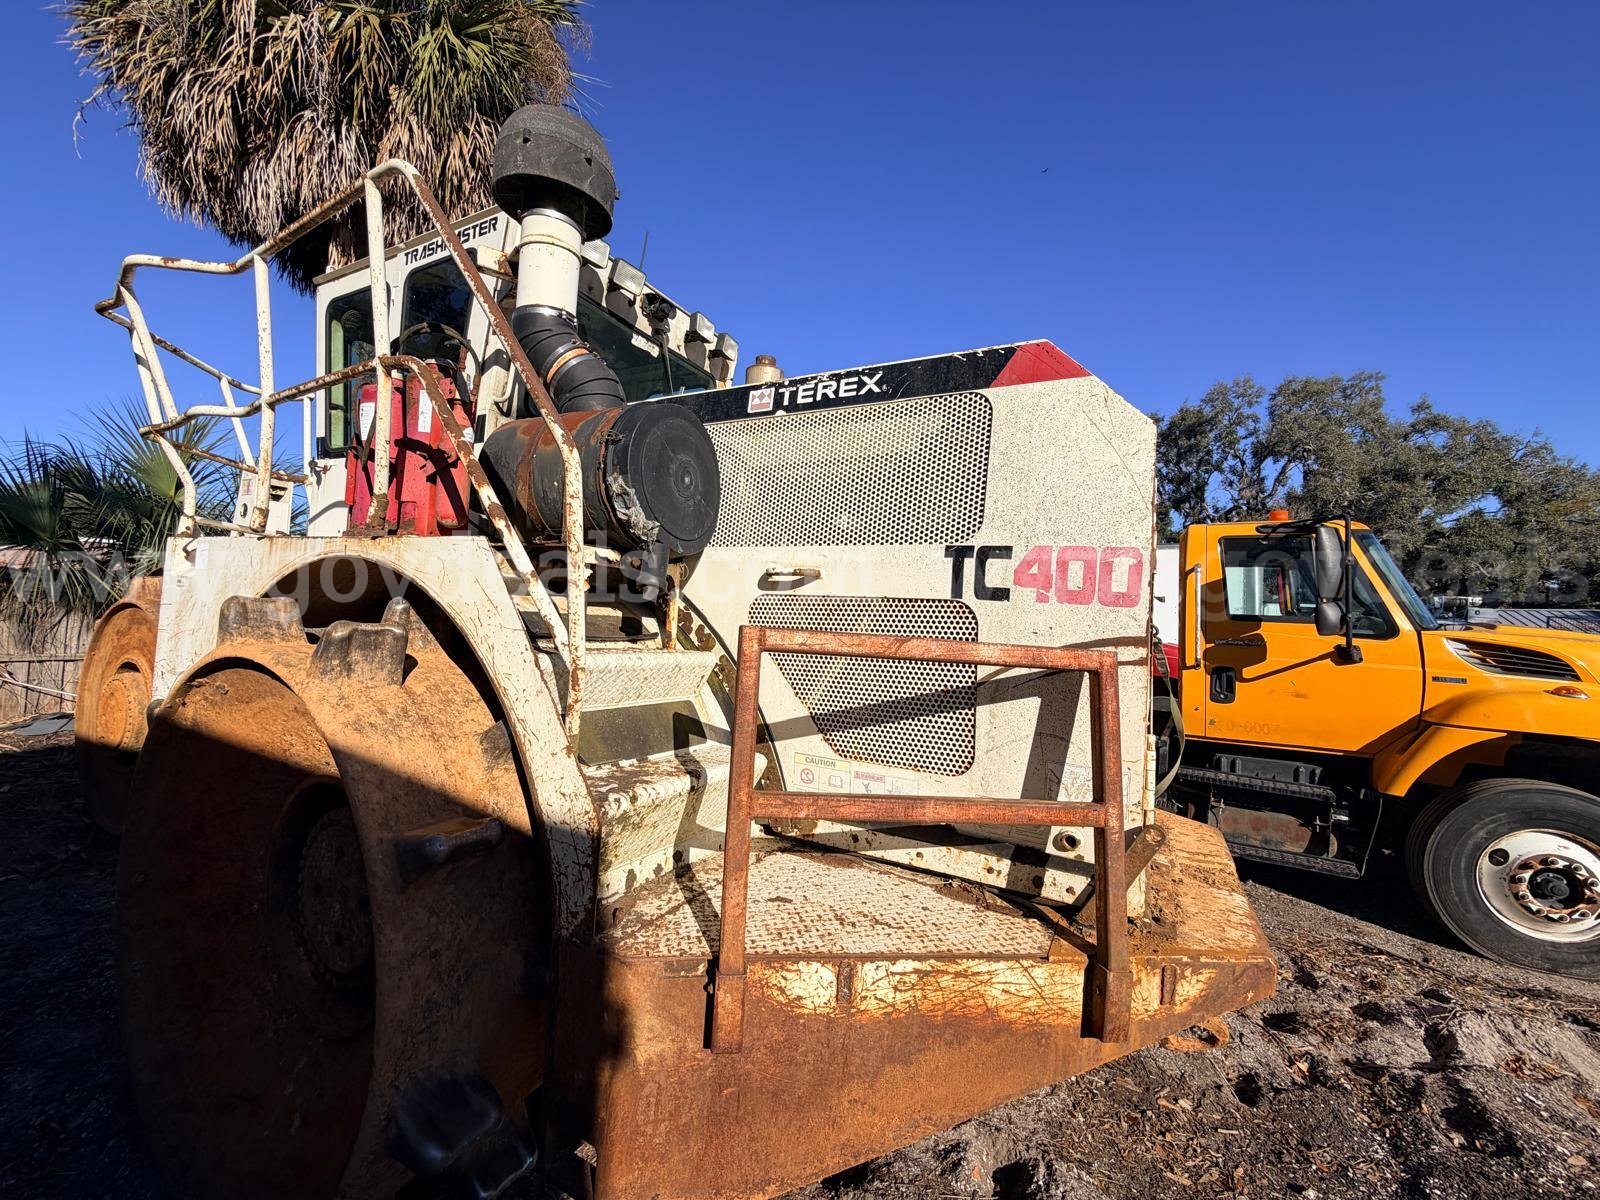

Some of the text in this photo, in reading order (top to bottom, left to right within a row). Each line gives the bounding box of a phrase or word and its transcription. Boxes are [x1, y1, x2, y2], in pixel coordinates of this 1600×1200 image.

[404, 216, 498, 265] TRASHASTER
[779, 371, 883, 406] TEREX
[944, 545, 1144, 608] TC400
[805, 757, 836, 768] CAUTION
